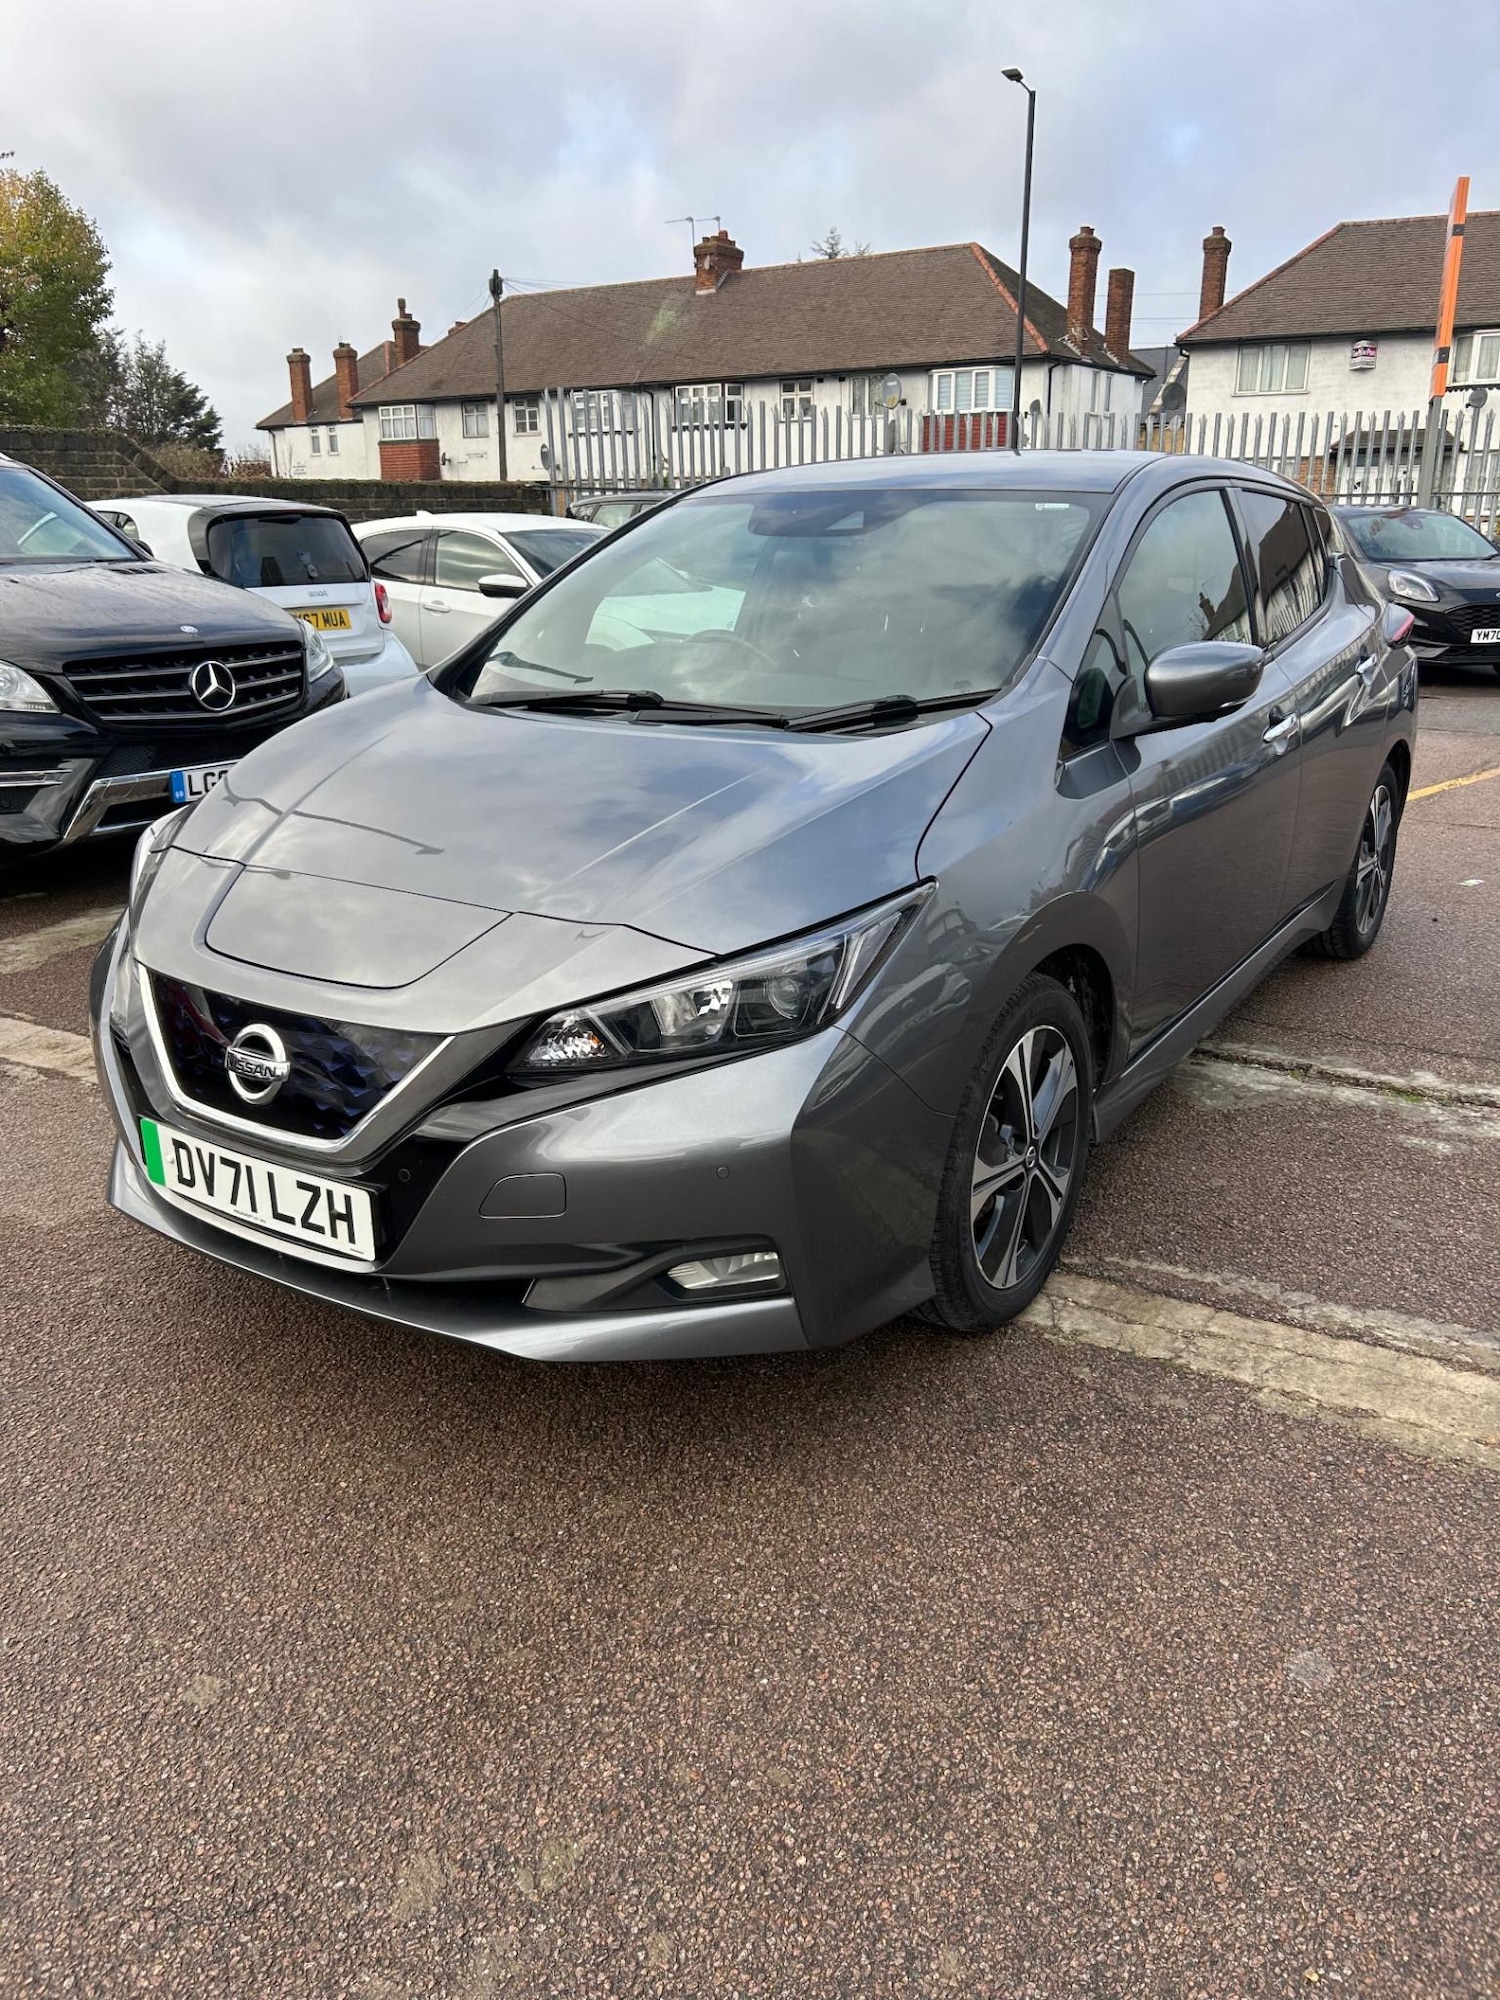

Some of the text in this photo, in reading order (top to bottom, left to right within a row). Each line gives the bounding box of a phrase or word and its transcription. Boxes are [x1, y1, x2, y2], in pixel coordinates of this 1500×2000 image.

[322, 612, 347, 628] MUA
[226, 1052, 277, 1079] NISSAN
[171, 1138, 356, 1245] DV71 LZH
